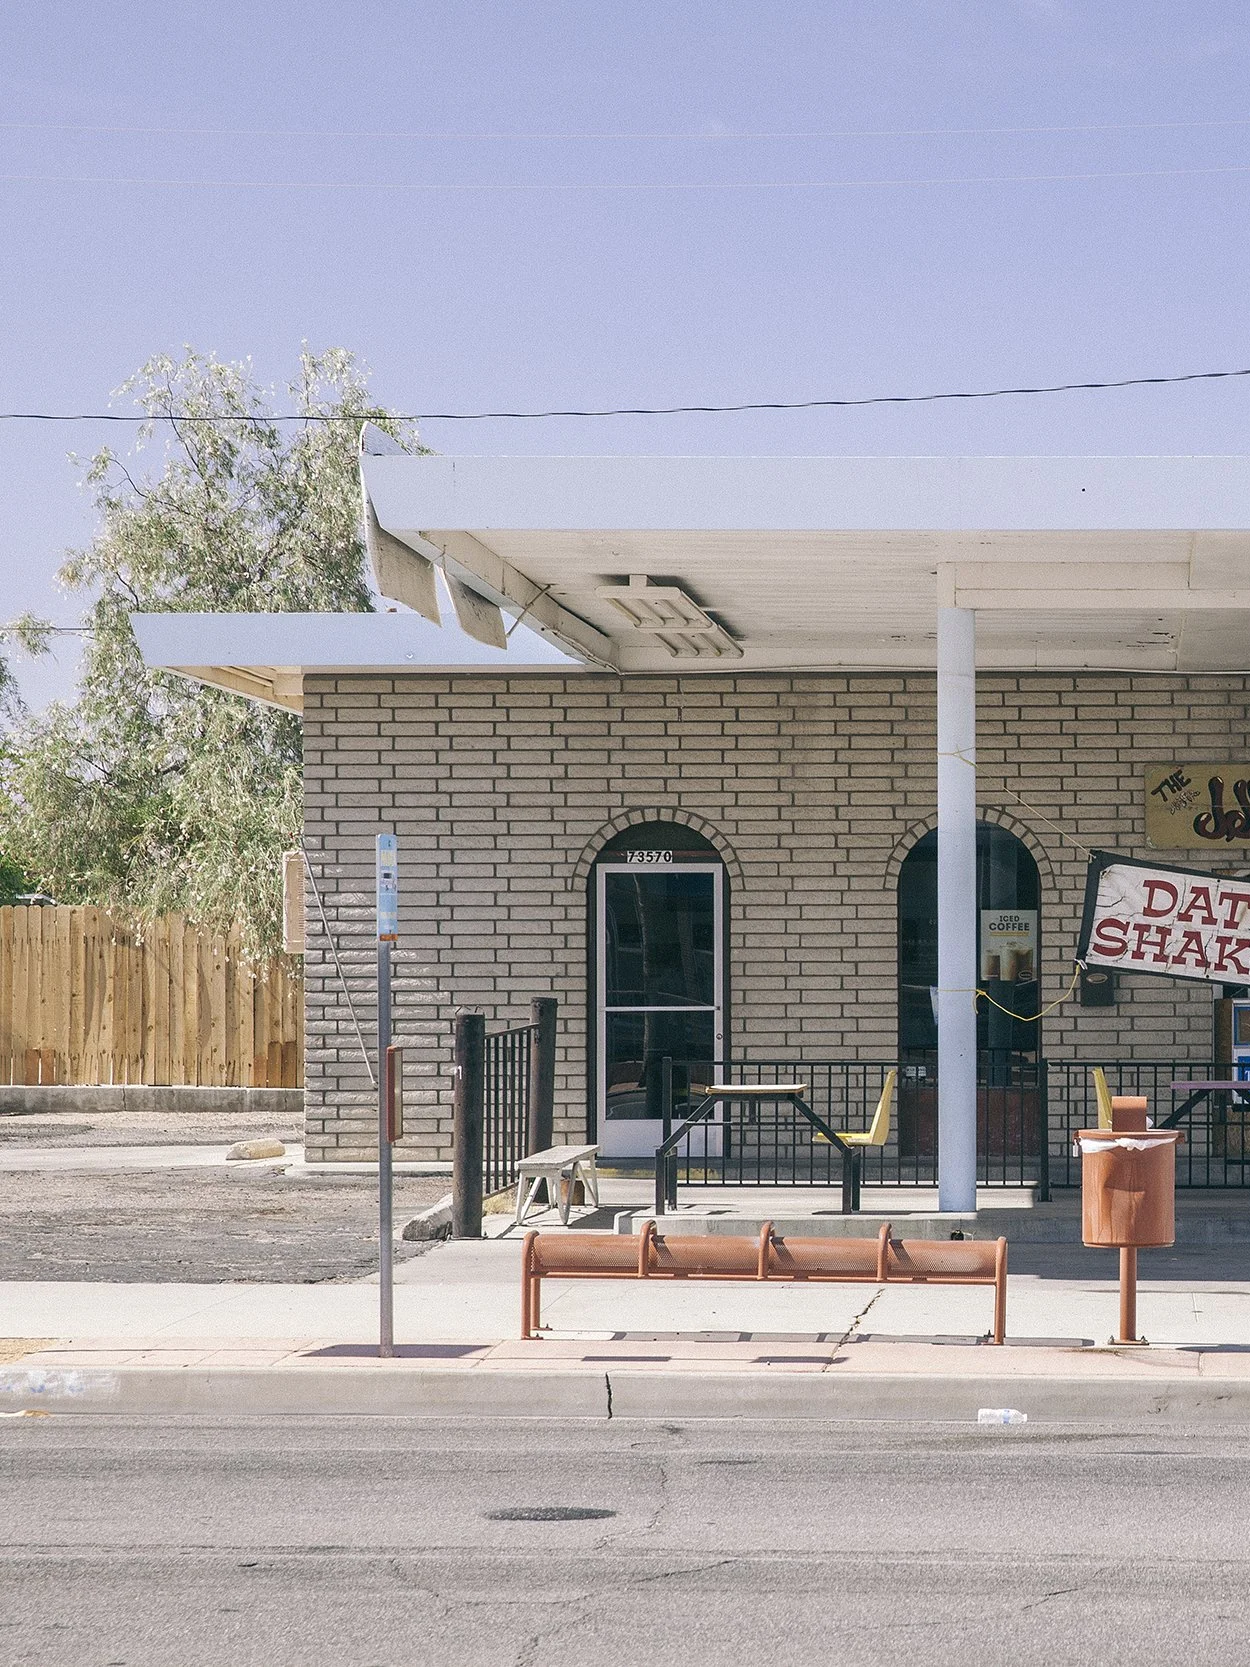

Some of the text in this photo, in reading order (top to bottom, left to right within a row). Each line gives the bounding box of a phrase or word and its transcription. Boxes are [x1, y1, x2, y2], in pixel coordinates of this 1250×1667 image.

[1151, 769, 1191, 802] THE
[629, 852, 672, 862] 73570
[989, 922, 1030, 931] COFFEE
